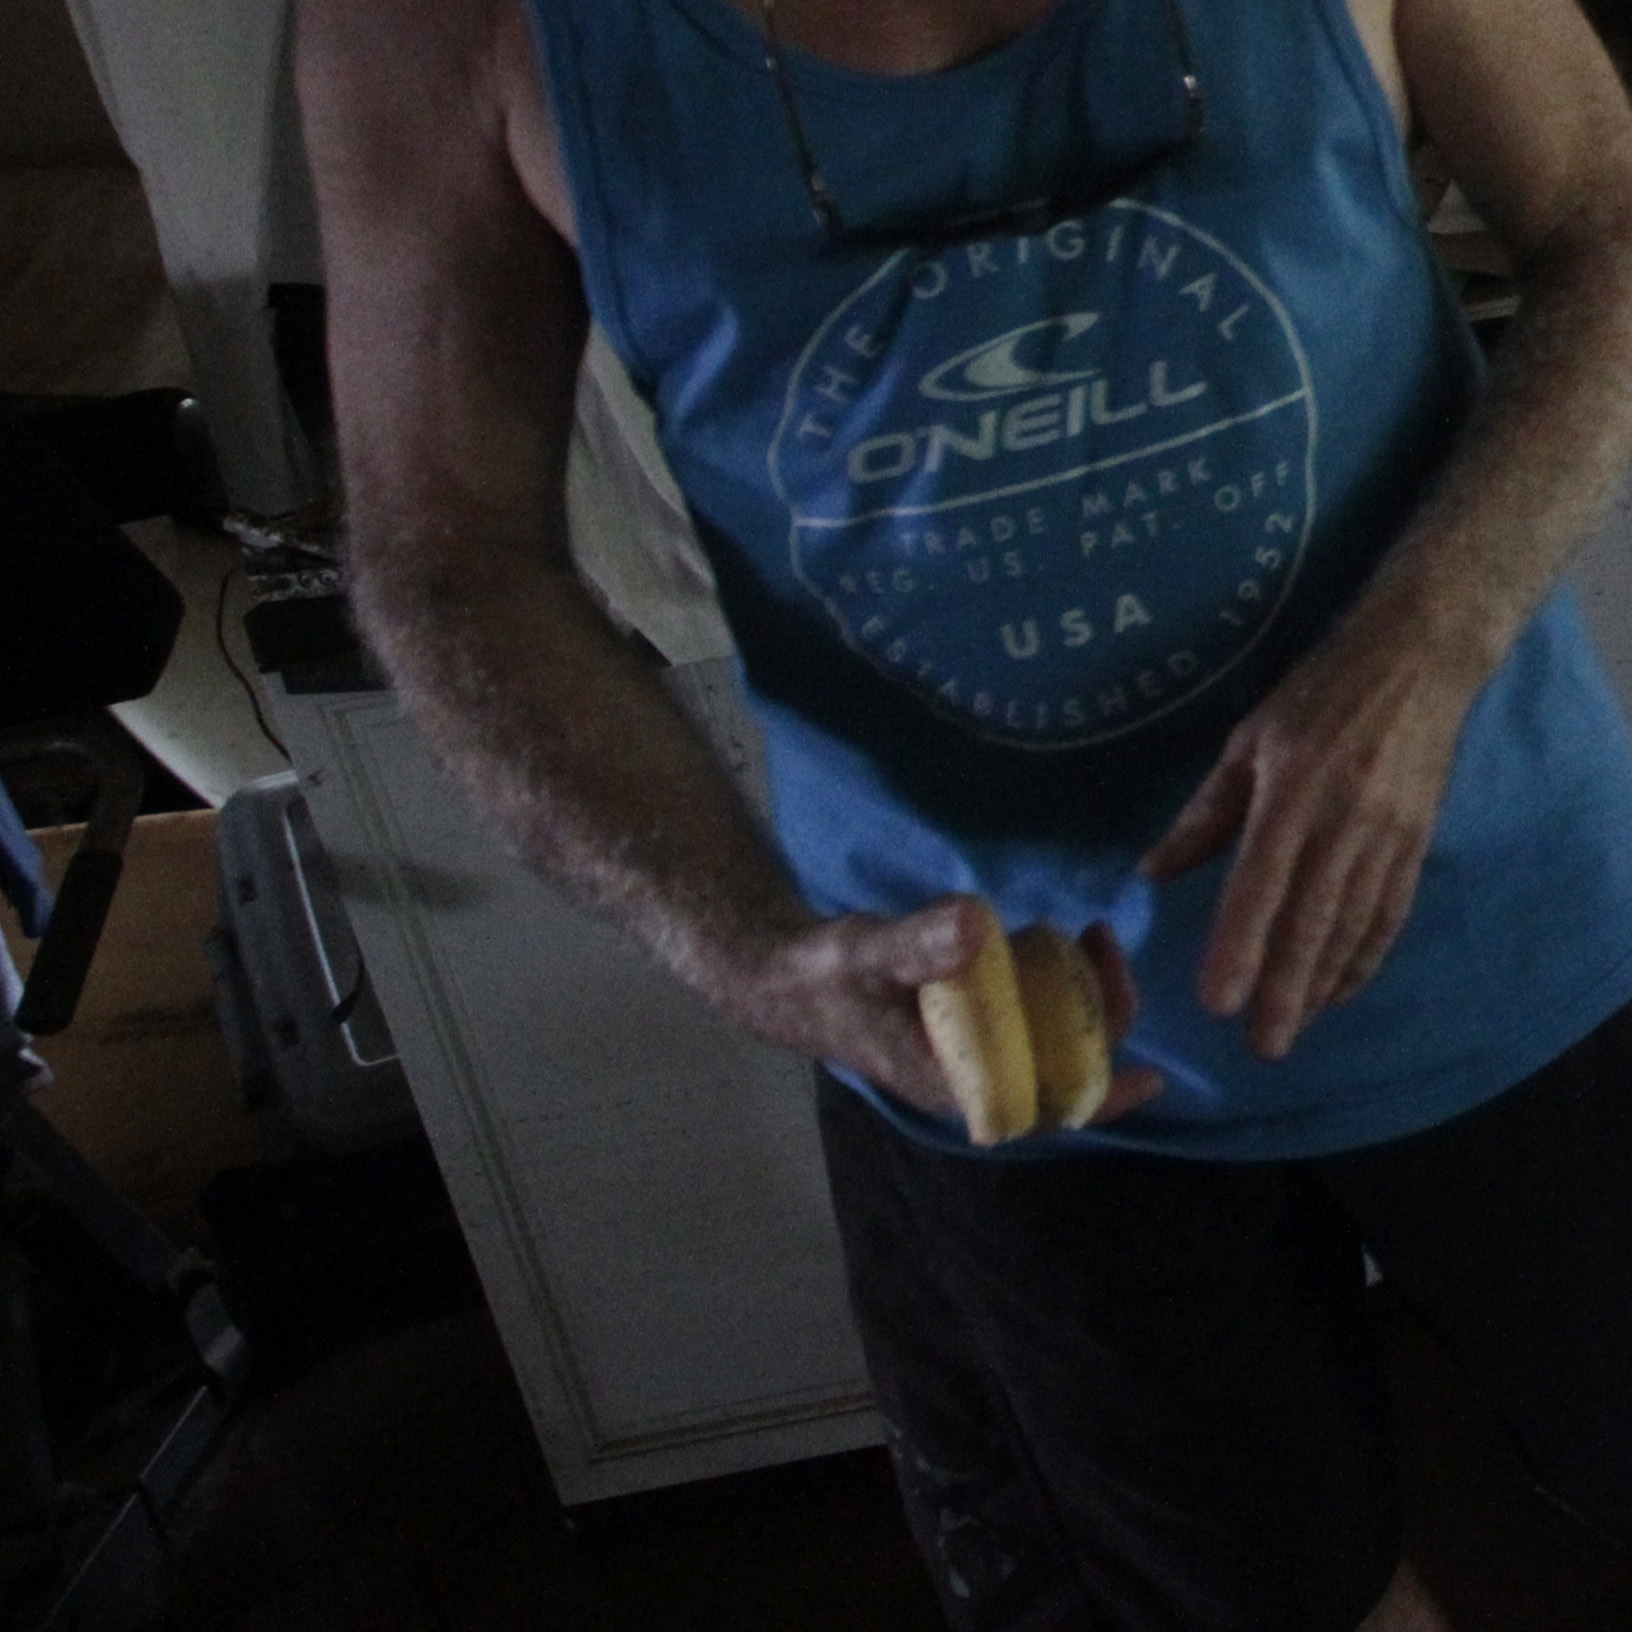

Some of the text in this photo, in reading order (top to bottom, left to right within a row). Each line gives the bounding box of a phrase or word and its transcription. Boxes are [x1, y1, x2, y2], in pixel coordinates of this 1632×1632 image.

[800, 218, 1251, 445] THE ORIGINAL
[901, 459, 1211, 557] TRADE MARK
[861, 511, 1296, 729] ESTABLISHED 1952
[1001, 592, 1154, 659] USA
